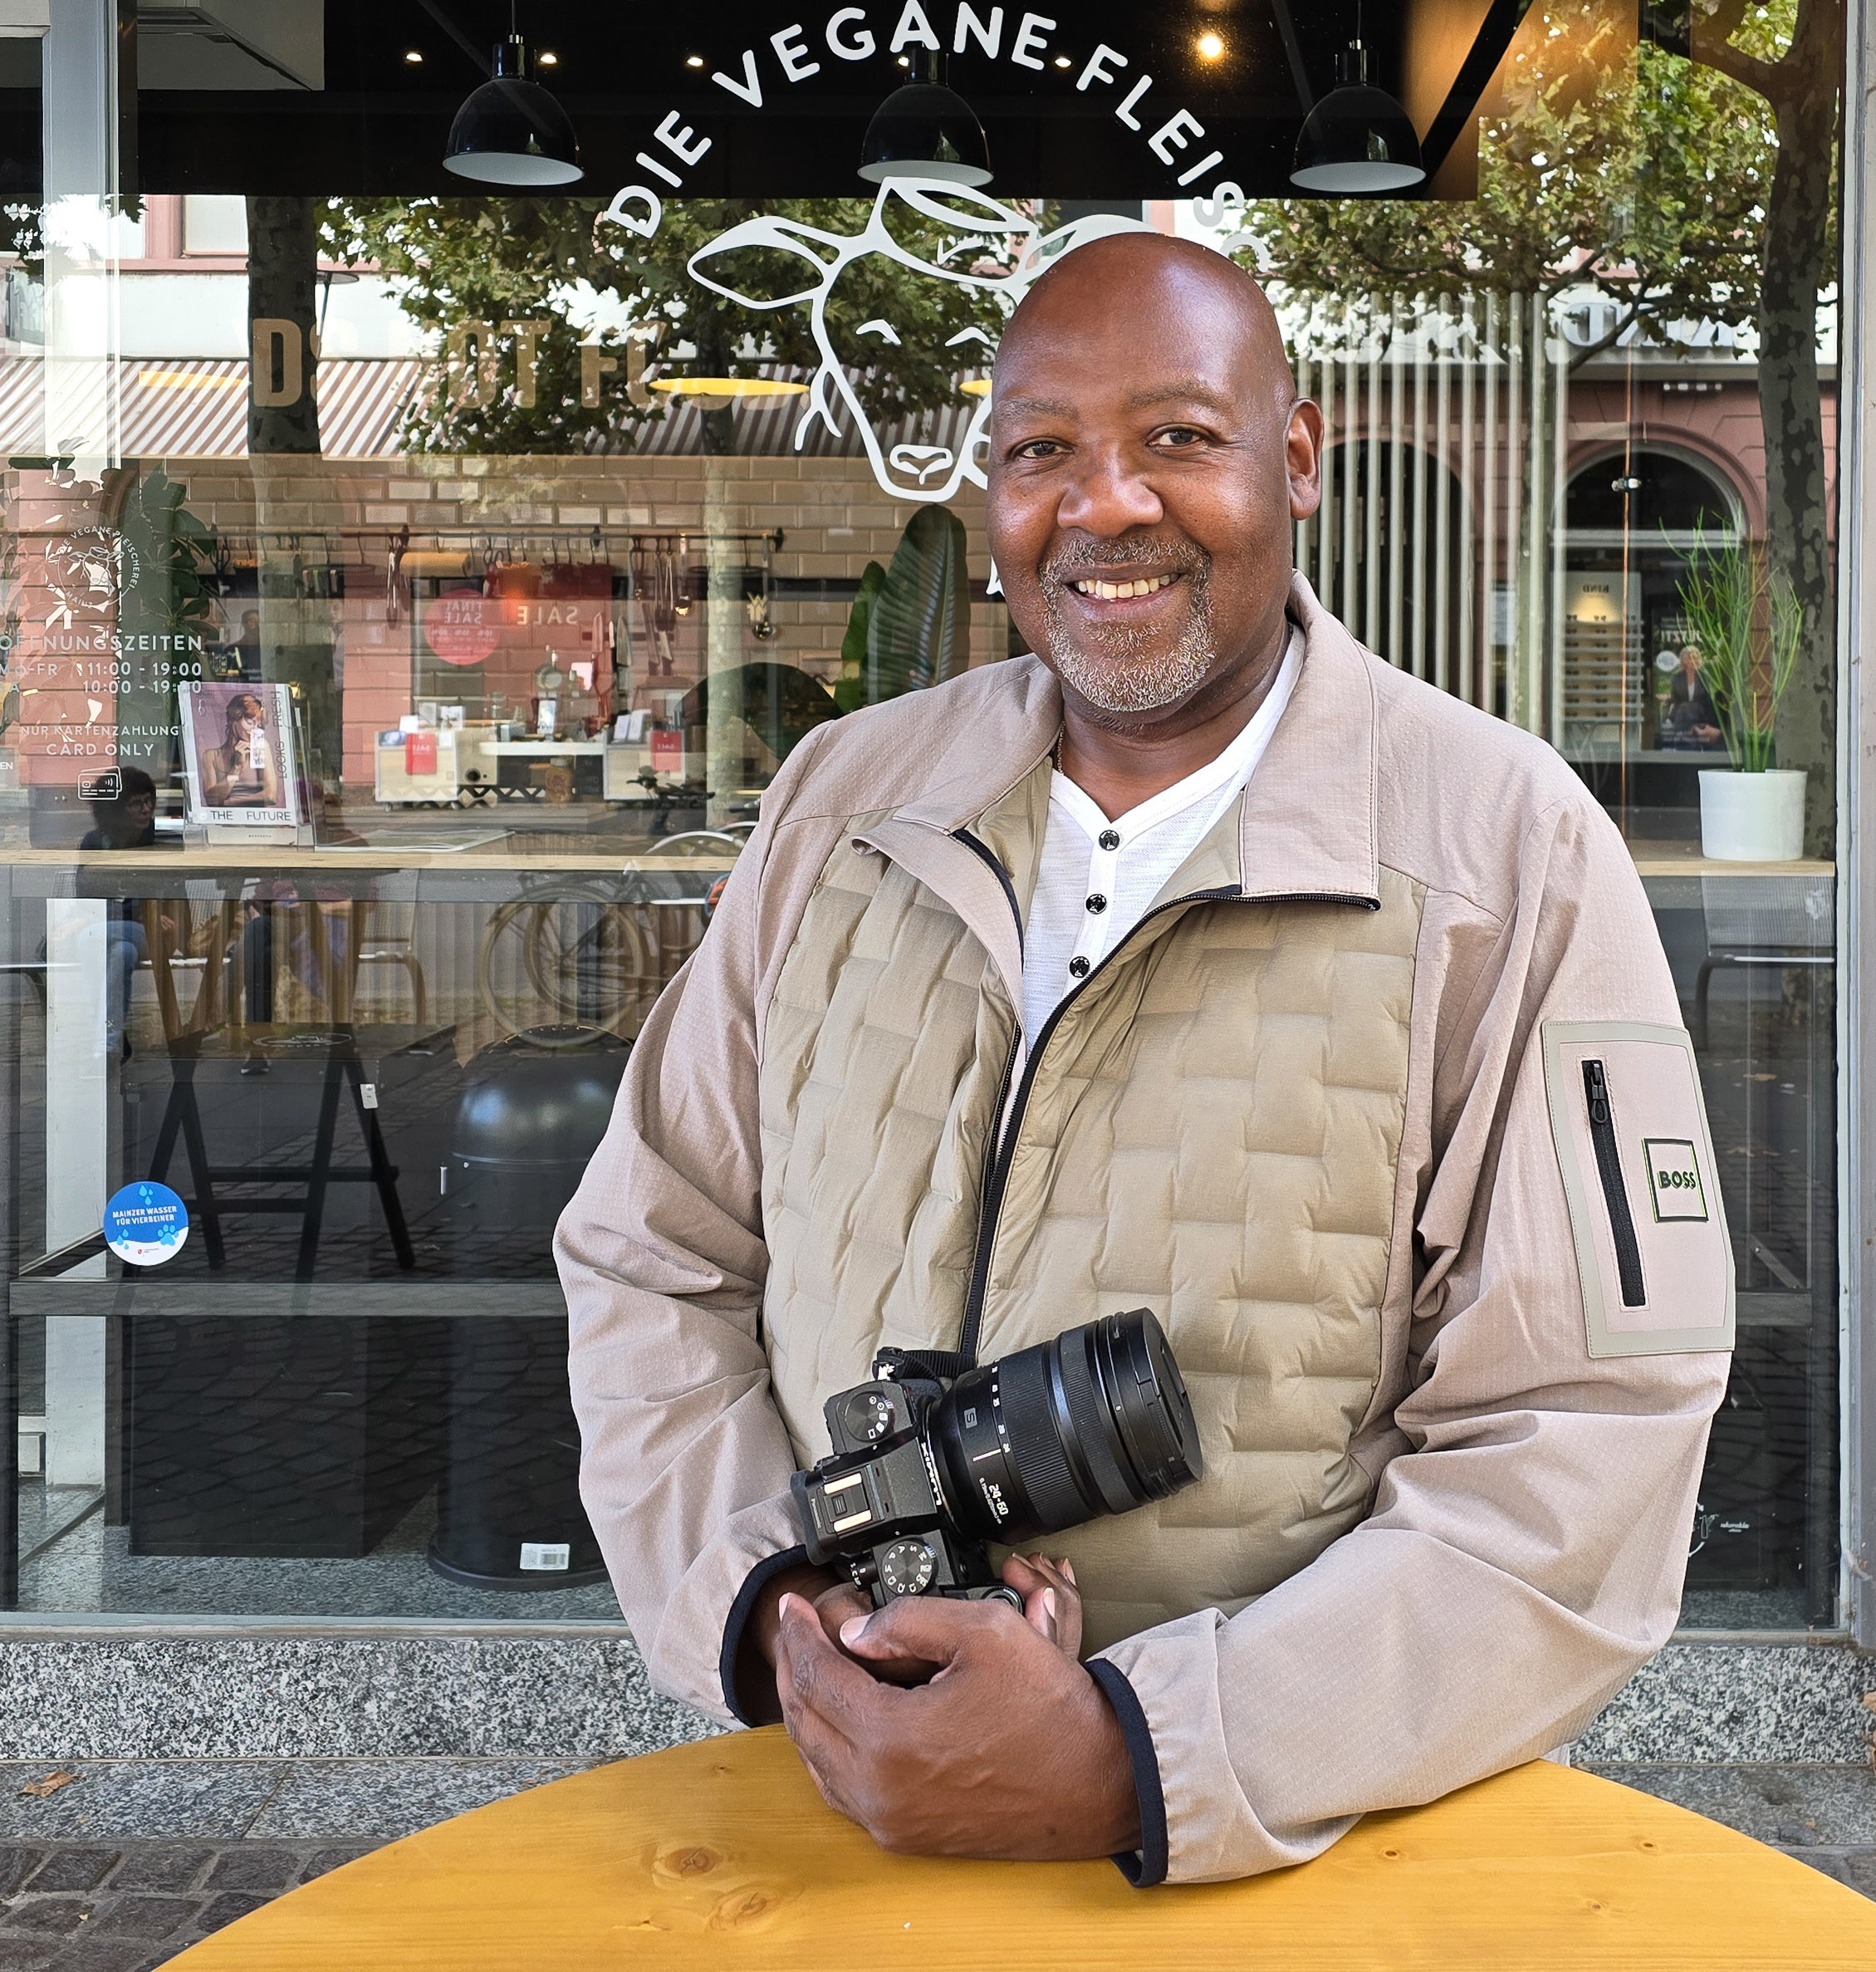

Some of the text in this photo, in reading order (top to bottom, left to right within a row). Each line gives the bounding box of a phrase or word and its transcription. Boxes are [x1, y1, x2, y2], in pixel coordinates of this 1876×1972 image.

[606, 0, 1271, 274] DIE VEGANE FLEISC
[71, 526, 113, 539] VEGANE
[88, 662, 131, 675] 11:00
[153, 662, 202, 676] 19:00
[83, 679, 131, 694] 10:00
[21, 726, 179, 736] NUR KARTENZAHLUNG
[271, 690, 288, 779] LOOKS FRESH
[46, 743, 154, 756] CARD ONLY
[210, 811, 291, 822] THE FUTURE
[1657, 1170, 1696, 1190] BOSS
[112, 1206, 177, 1219] MAINZER WASSER
[115, 1214, 175, 1226] FÜR VIERBEINER
[921, 1442, 942, 1505] LUMIX
[989, 1484, 1009, 1515] 24-60
